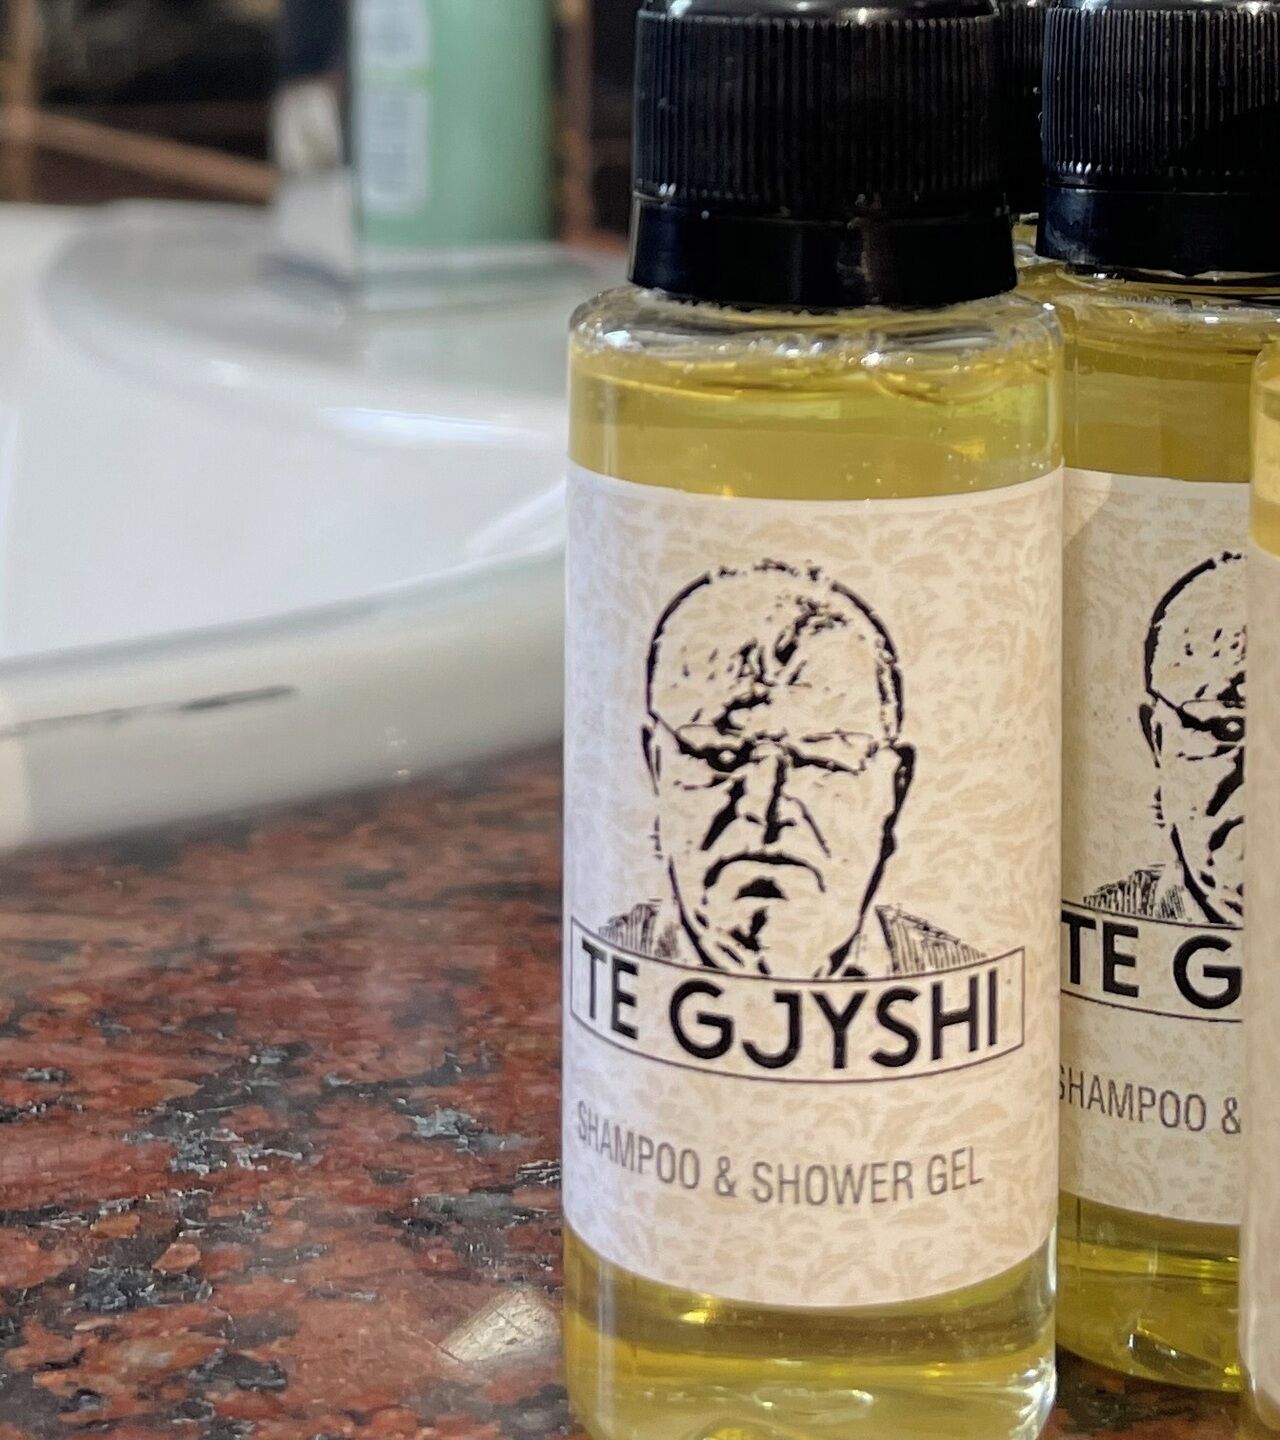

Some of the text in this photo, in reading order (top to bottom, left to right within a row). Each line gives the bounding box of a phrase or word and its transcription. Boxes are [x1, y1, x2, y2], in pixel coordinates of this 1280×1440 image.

[1061, 910, 1139, 998] TE
[581, 939, 998, 1070] TE GJYSHI
[577, 1099, 984, 1206] SHAMPOO & SHOWER GEL
[1221, 1097, 1242, 1135] &
